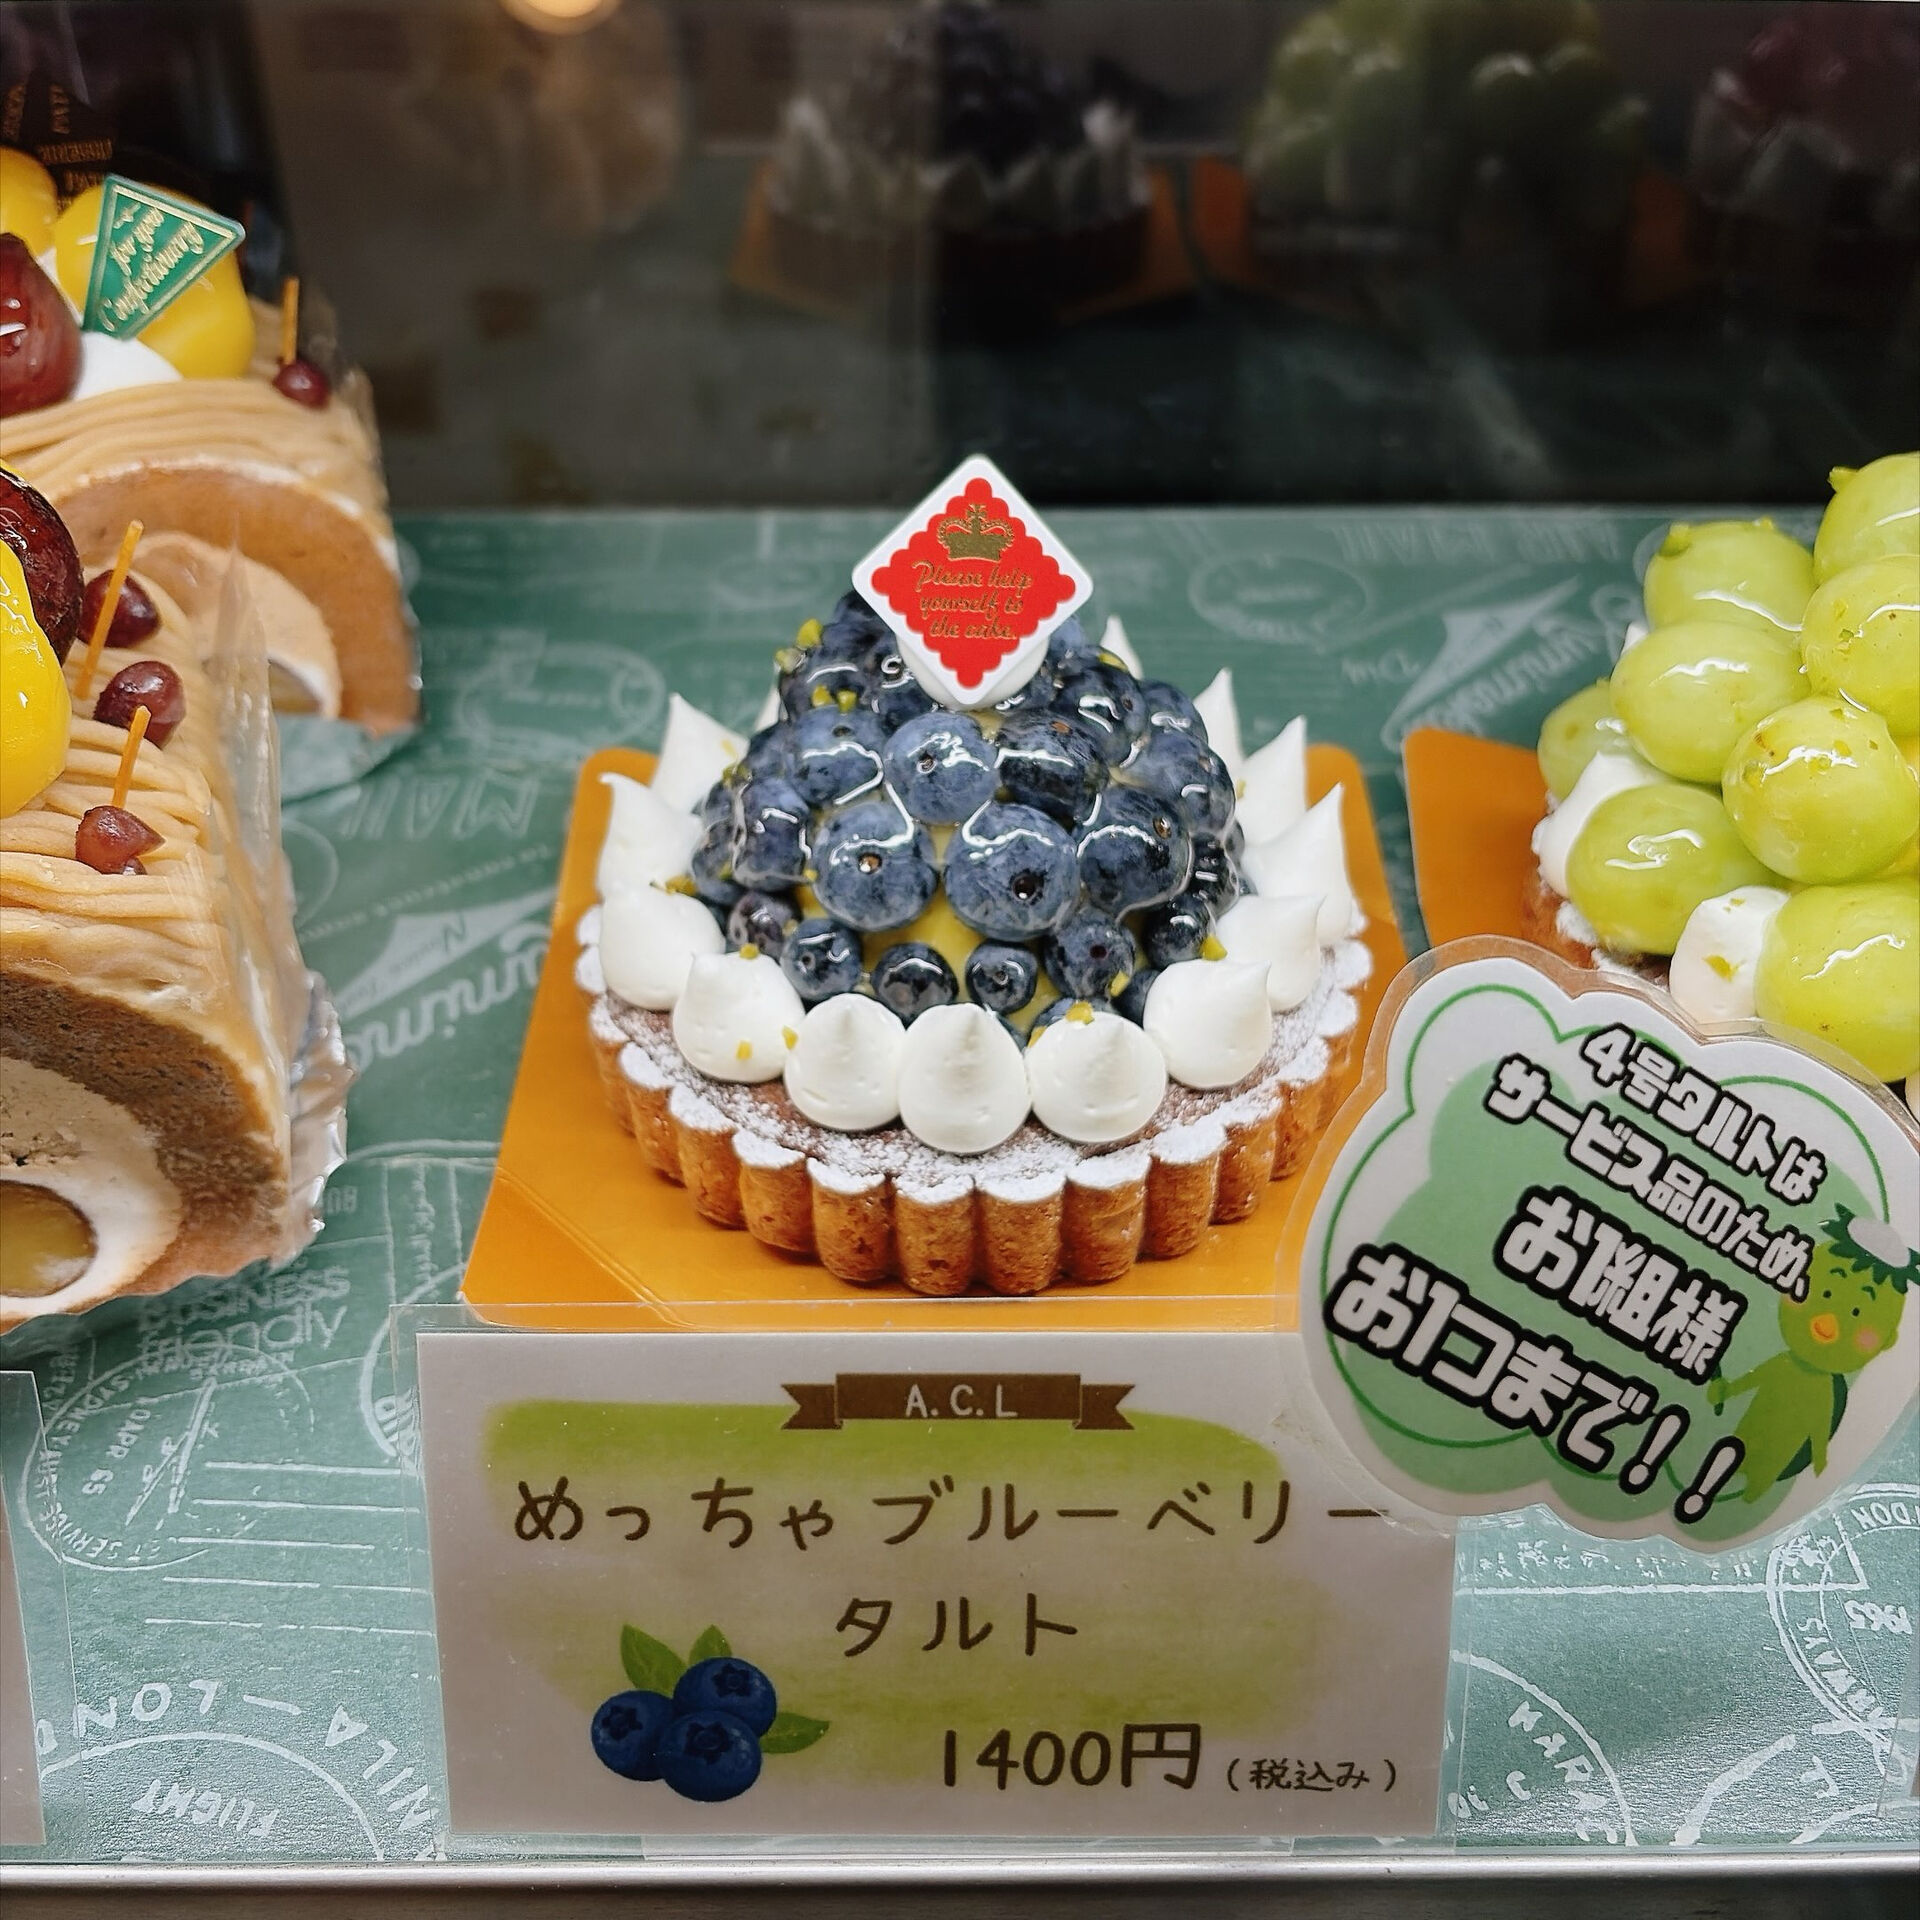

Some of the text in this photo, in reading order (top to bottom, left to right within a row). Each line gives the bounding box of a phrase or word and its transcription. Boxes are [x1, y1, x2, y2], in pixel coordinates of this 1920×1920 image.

[911, 560, 1033, 598] Please help
[920, 589, 1024, 621] yourself to
[929, 615, 960, 638] the
[1579, 1021, 1828, 1205] 4号タルトは
[1484, 1053, 1815, 1301] サービス品のため、
[1495, 1184, 1750, 1385] お1組様
[904, 1384, 1018, 1419] A.C.L
[515, 1475, 1388, 1552] めっちゃブルーベリー
[835, 1592, 1078, 1658] タルト
[943, 1722, 1397, 1793] 1400円 (税込み)
